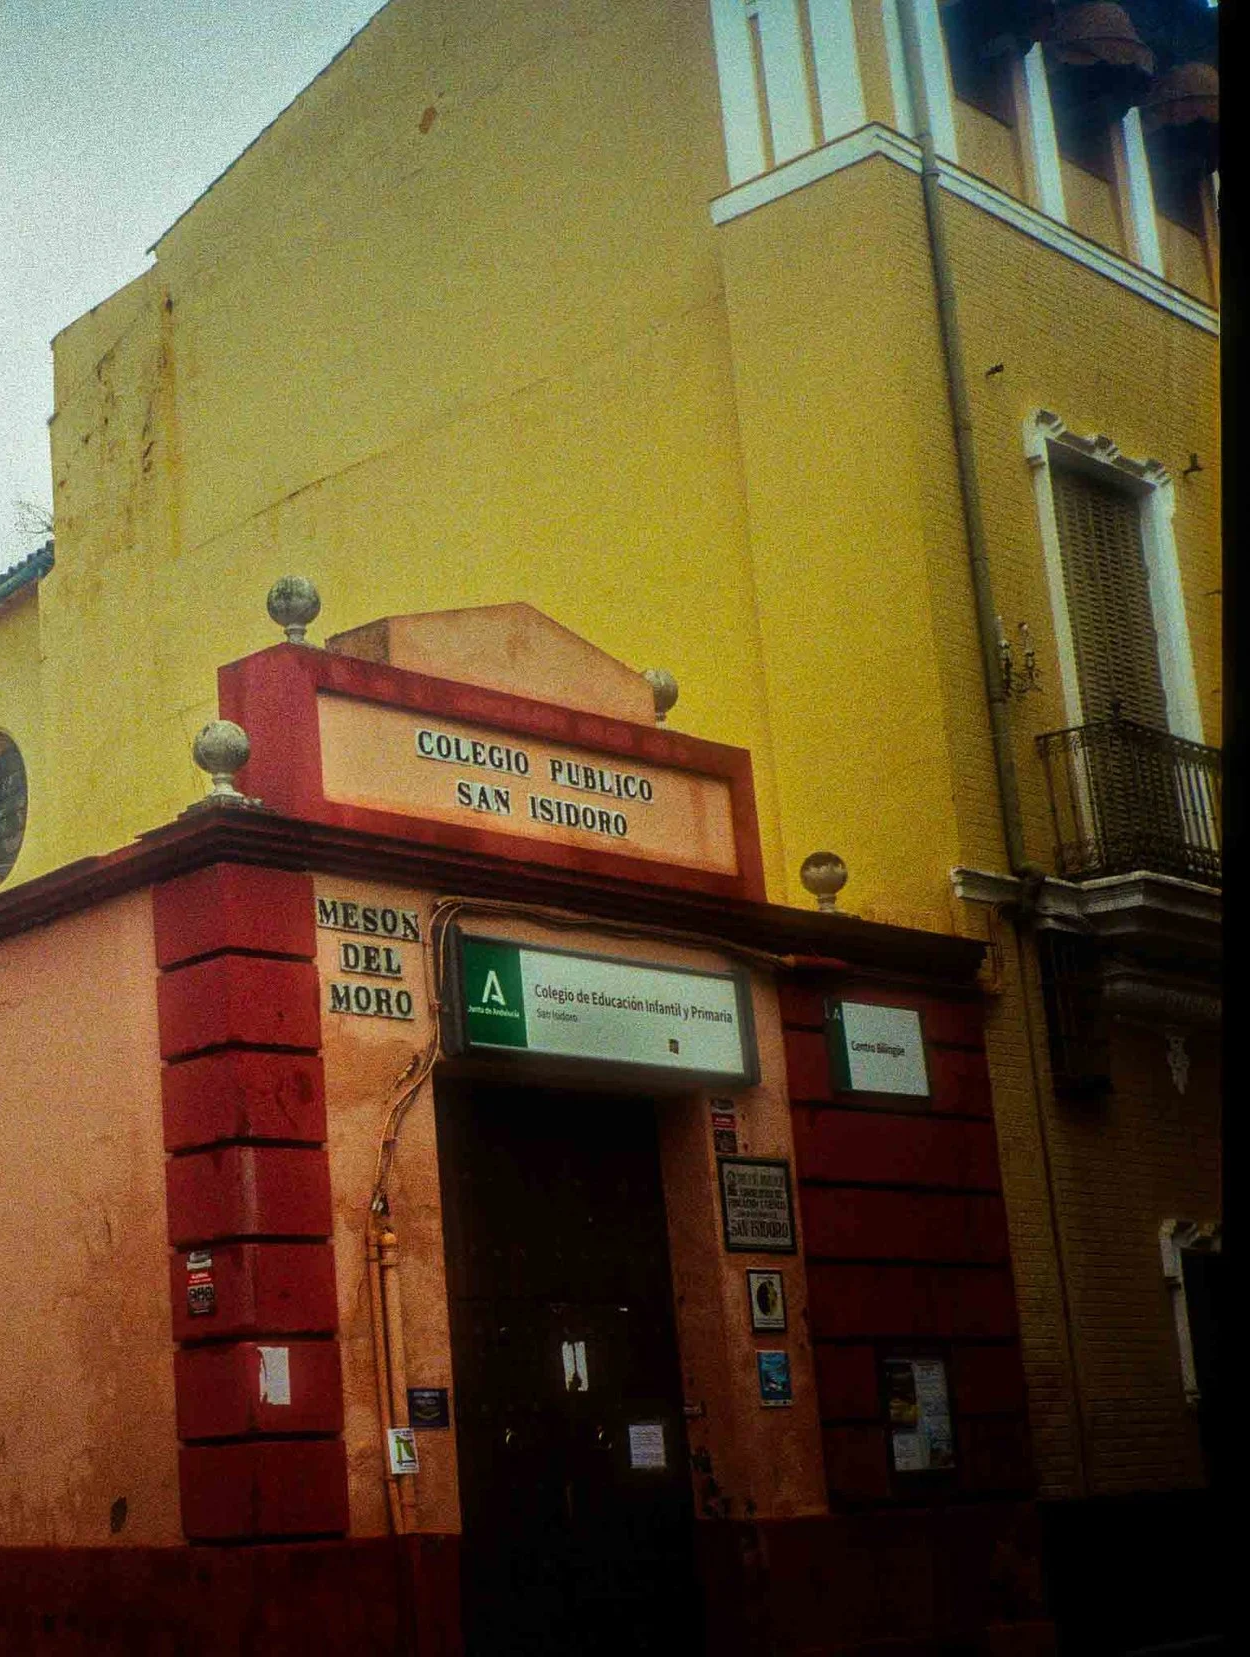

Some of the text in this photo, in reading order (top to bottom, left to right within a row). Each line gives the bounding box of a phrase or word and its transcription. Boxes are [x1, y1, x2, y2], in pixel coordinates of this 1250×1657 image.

[418, 731, 653, 801] COLEGIO PUBLICO
[457, 781, 627, 836] SAN ISIDORO
[317, 899, 420, 940] MESON
[342, 943, 401, 975] DEL
[331, 984, 412, 1017] MORO
[535, 984, 733, 1023] Colegio de Educación Infantil y Primaria
[536, 1008, 578, 1022] San Isidoro
[851, 1040, 876, 1053] Centro
